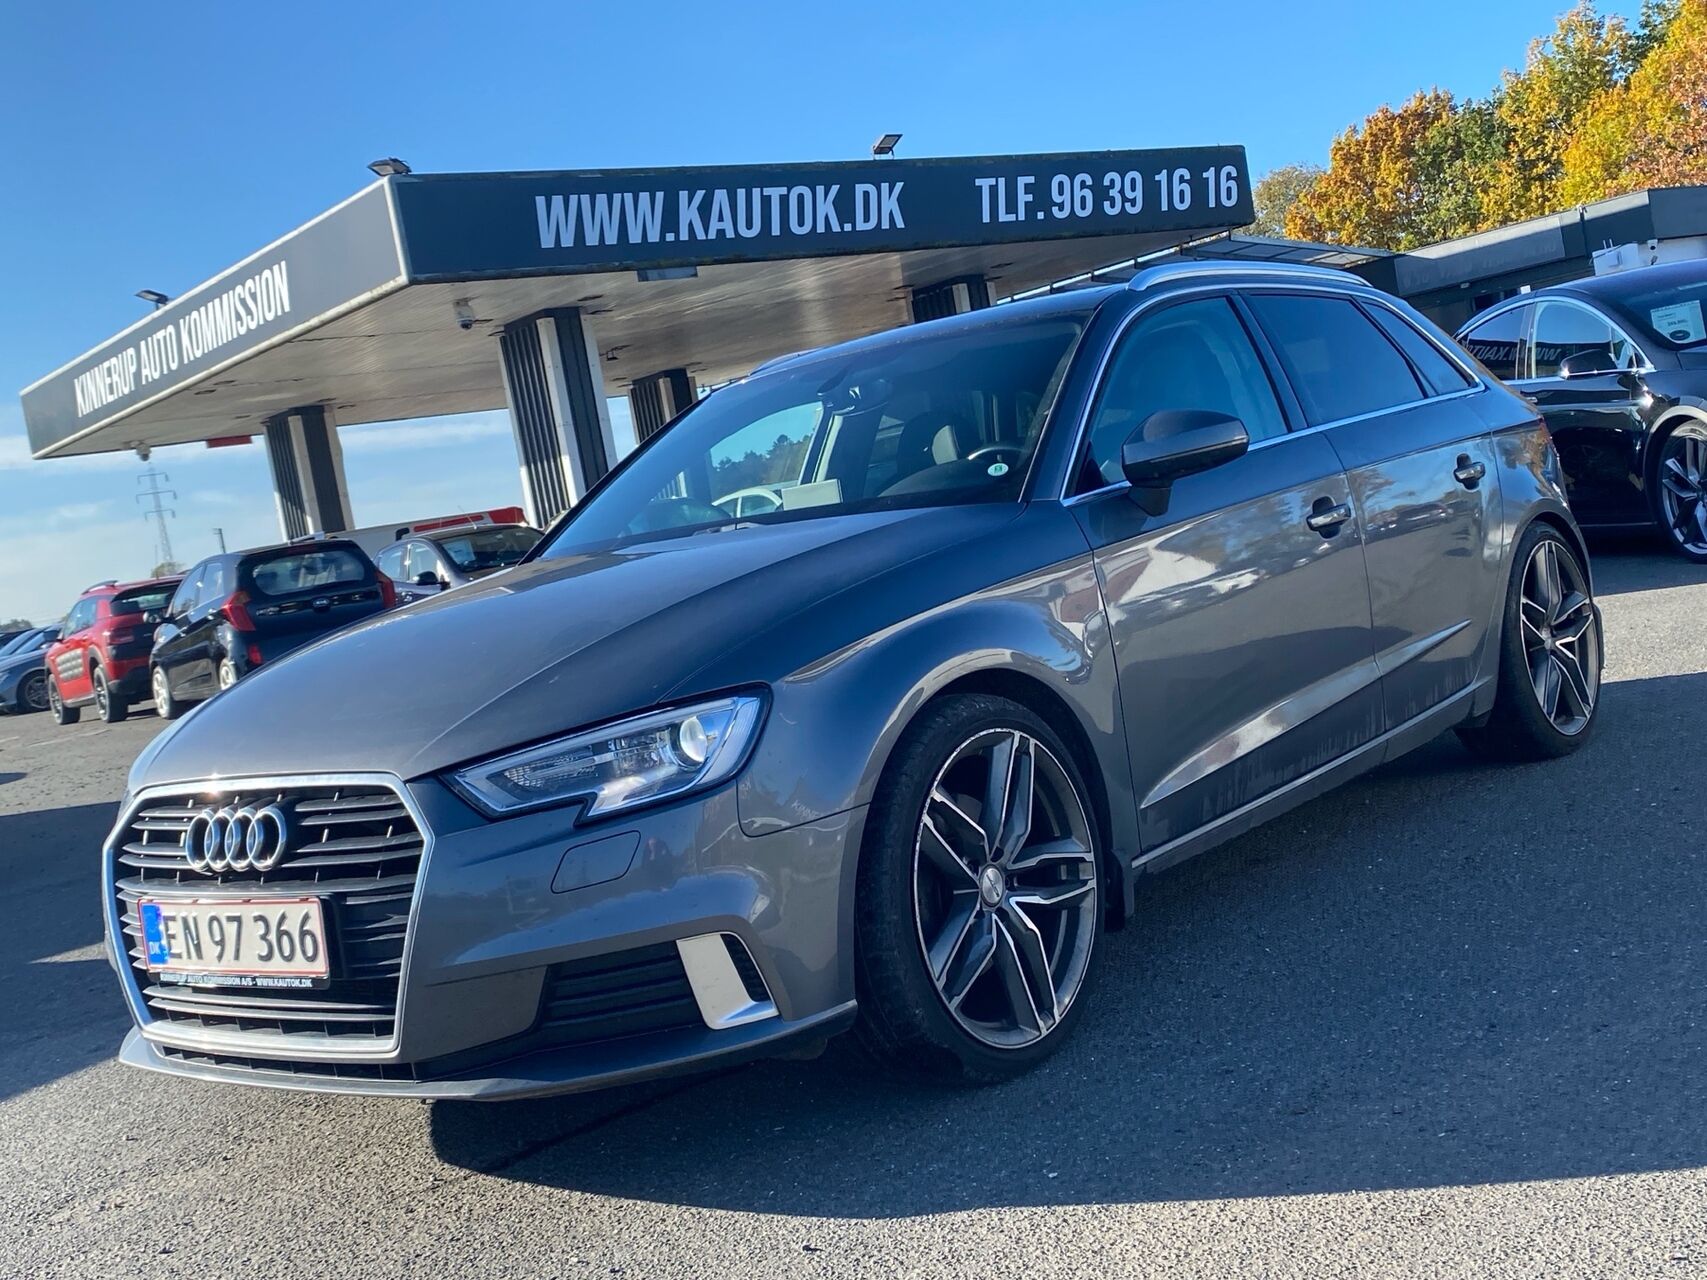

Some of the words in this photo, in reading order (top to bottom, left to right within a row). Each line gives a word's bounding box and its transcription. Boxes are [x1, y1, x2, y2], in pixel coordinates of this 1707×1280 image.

[535, 182, 905, 248] WWW.KAUTOK.DK
[1102, 171, 1143, 216] 39
[1154, 168, 1191, 212] 16
[1202, 165, 1238, 208] 16
[74, 347, 137, 418] KINNERUP
[140, 324, 179, 385] AUTO
[179, 260, 290, 364] KOMMISSION
[162, 913, 204, 960] EN
[207, 913, 242, 963] 97
[252, 910, 319, 963] 366
